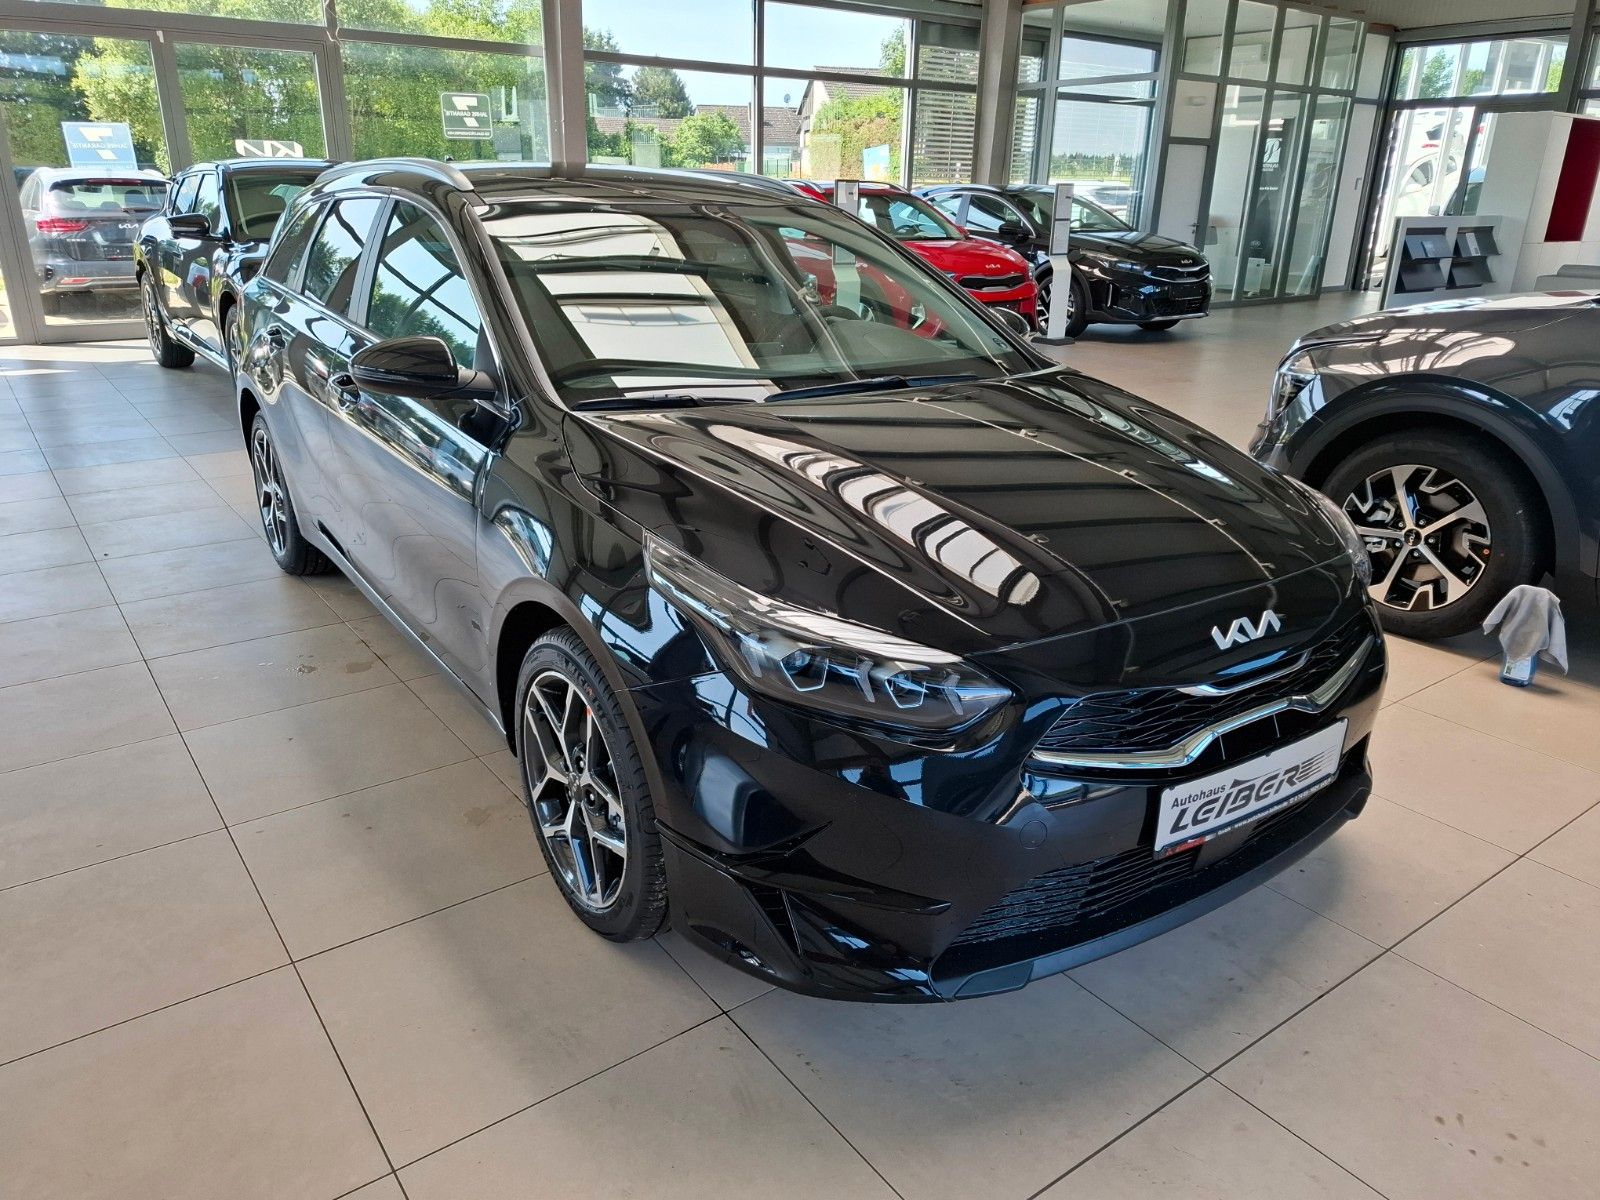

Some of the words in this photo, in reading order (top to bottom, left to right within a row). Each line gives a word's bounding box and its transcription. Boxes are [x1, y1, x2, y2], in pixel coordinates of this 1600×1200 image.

[1211, 609, 1281, 650] KIA
[1169, 764, 1303, 834] LEIBER
[1171, 784, 1226, 810] Autohaus
